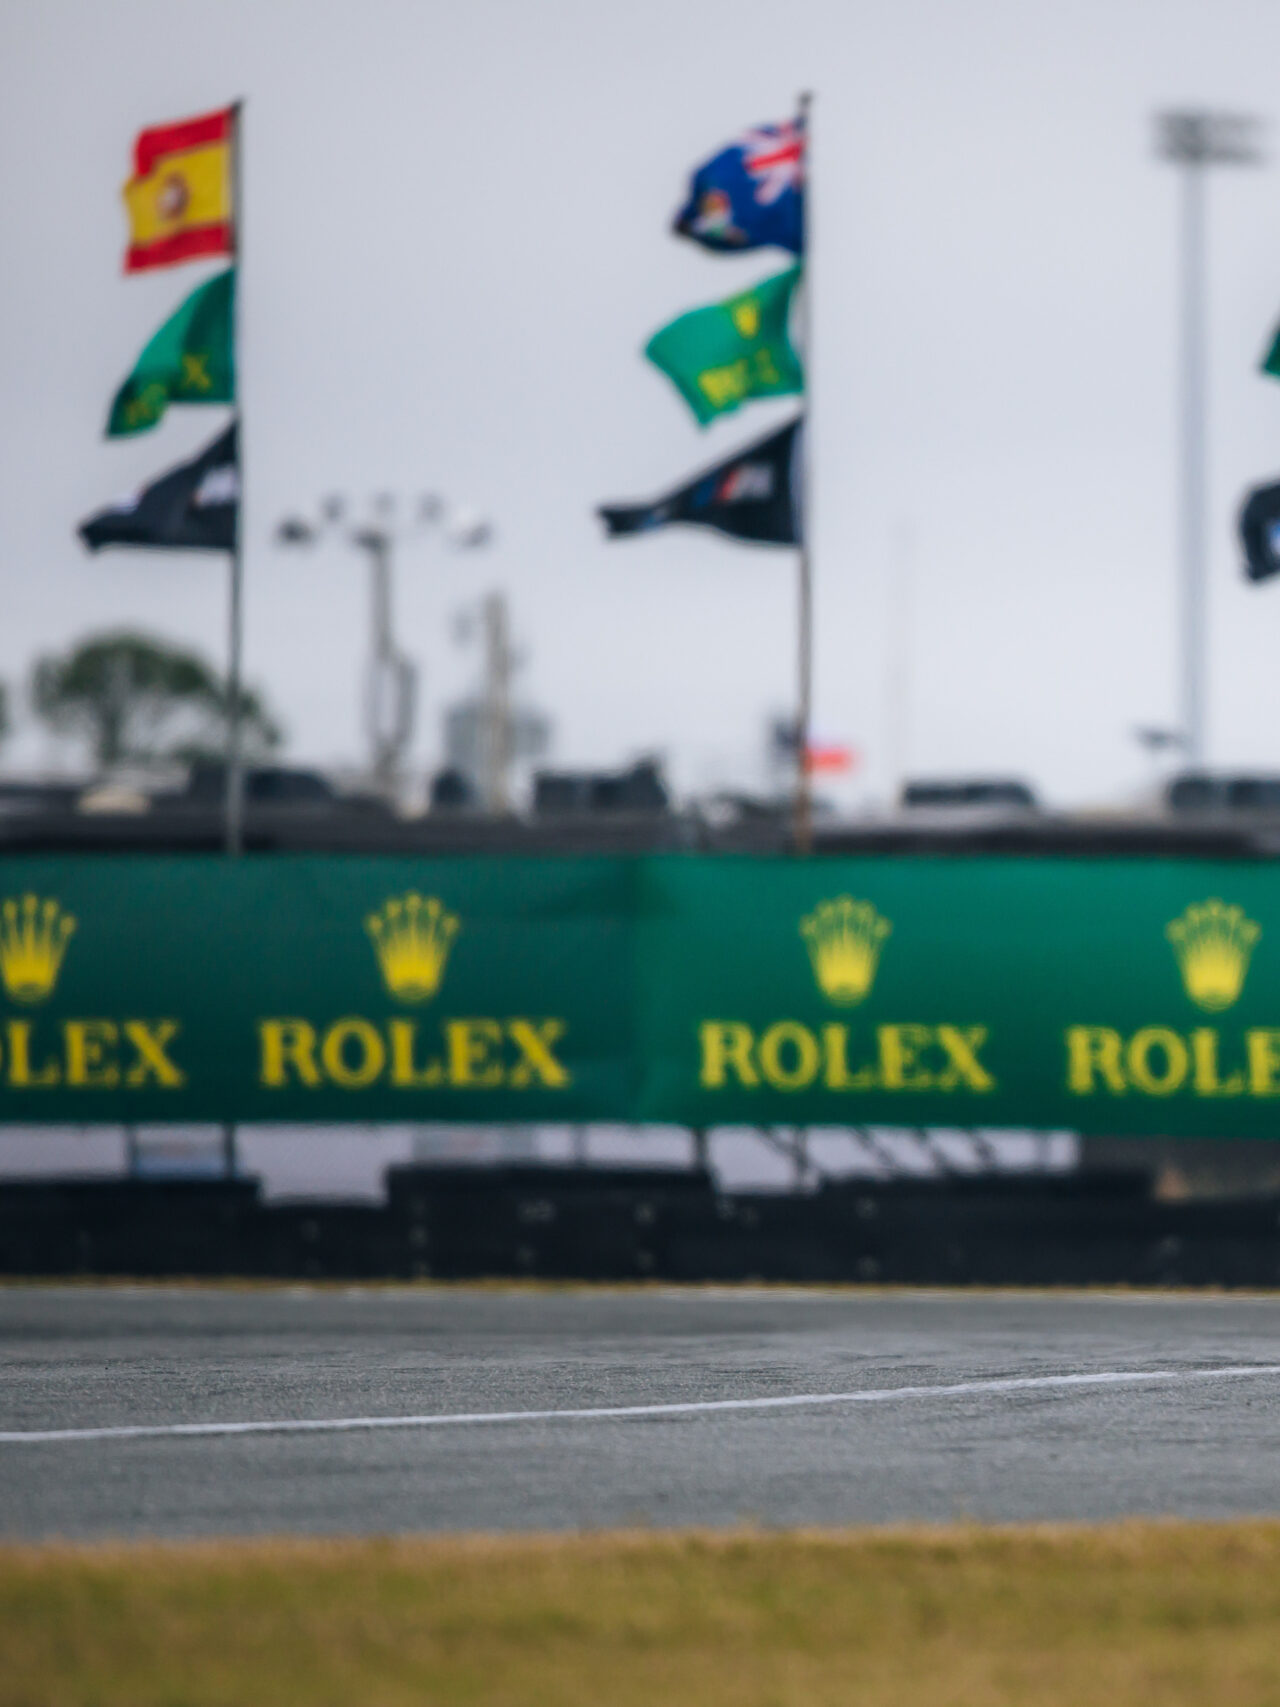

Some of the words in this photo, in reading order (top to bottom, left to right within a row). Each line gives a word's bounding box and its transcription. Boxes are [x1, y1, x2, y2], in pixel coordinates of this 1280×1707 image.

[0, 1020, 184, 1088] LEX
[259, 1018, 569, 1089] ROLEX
[698, 1020, 995, 1092] ROLEX
